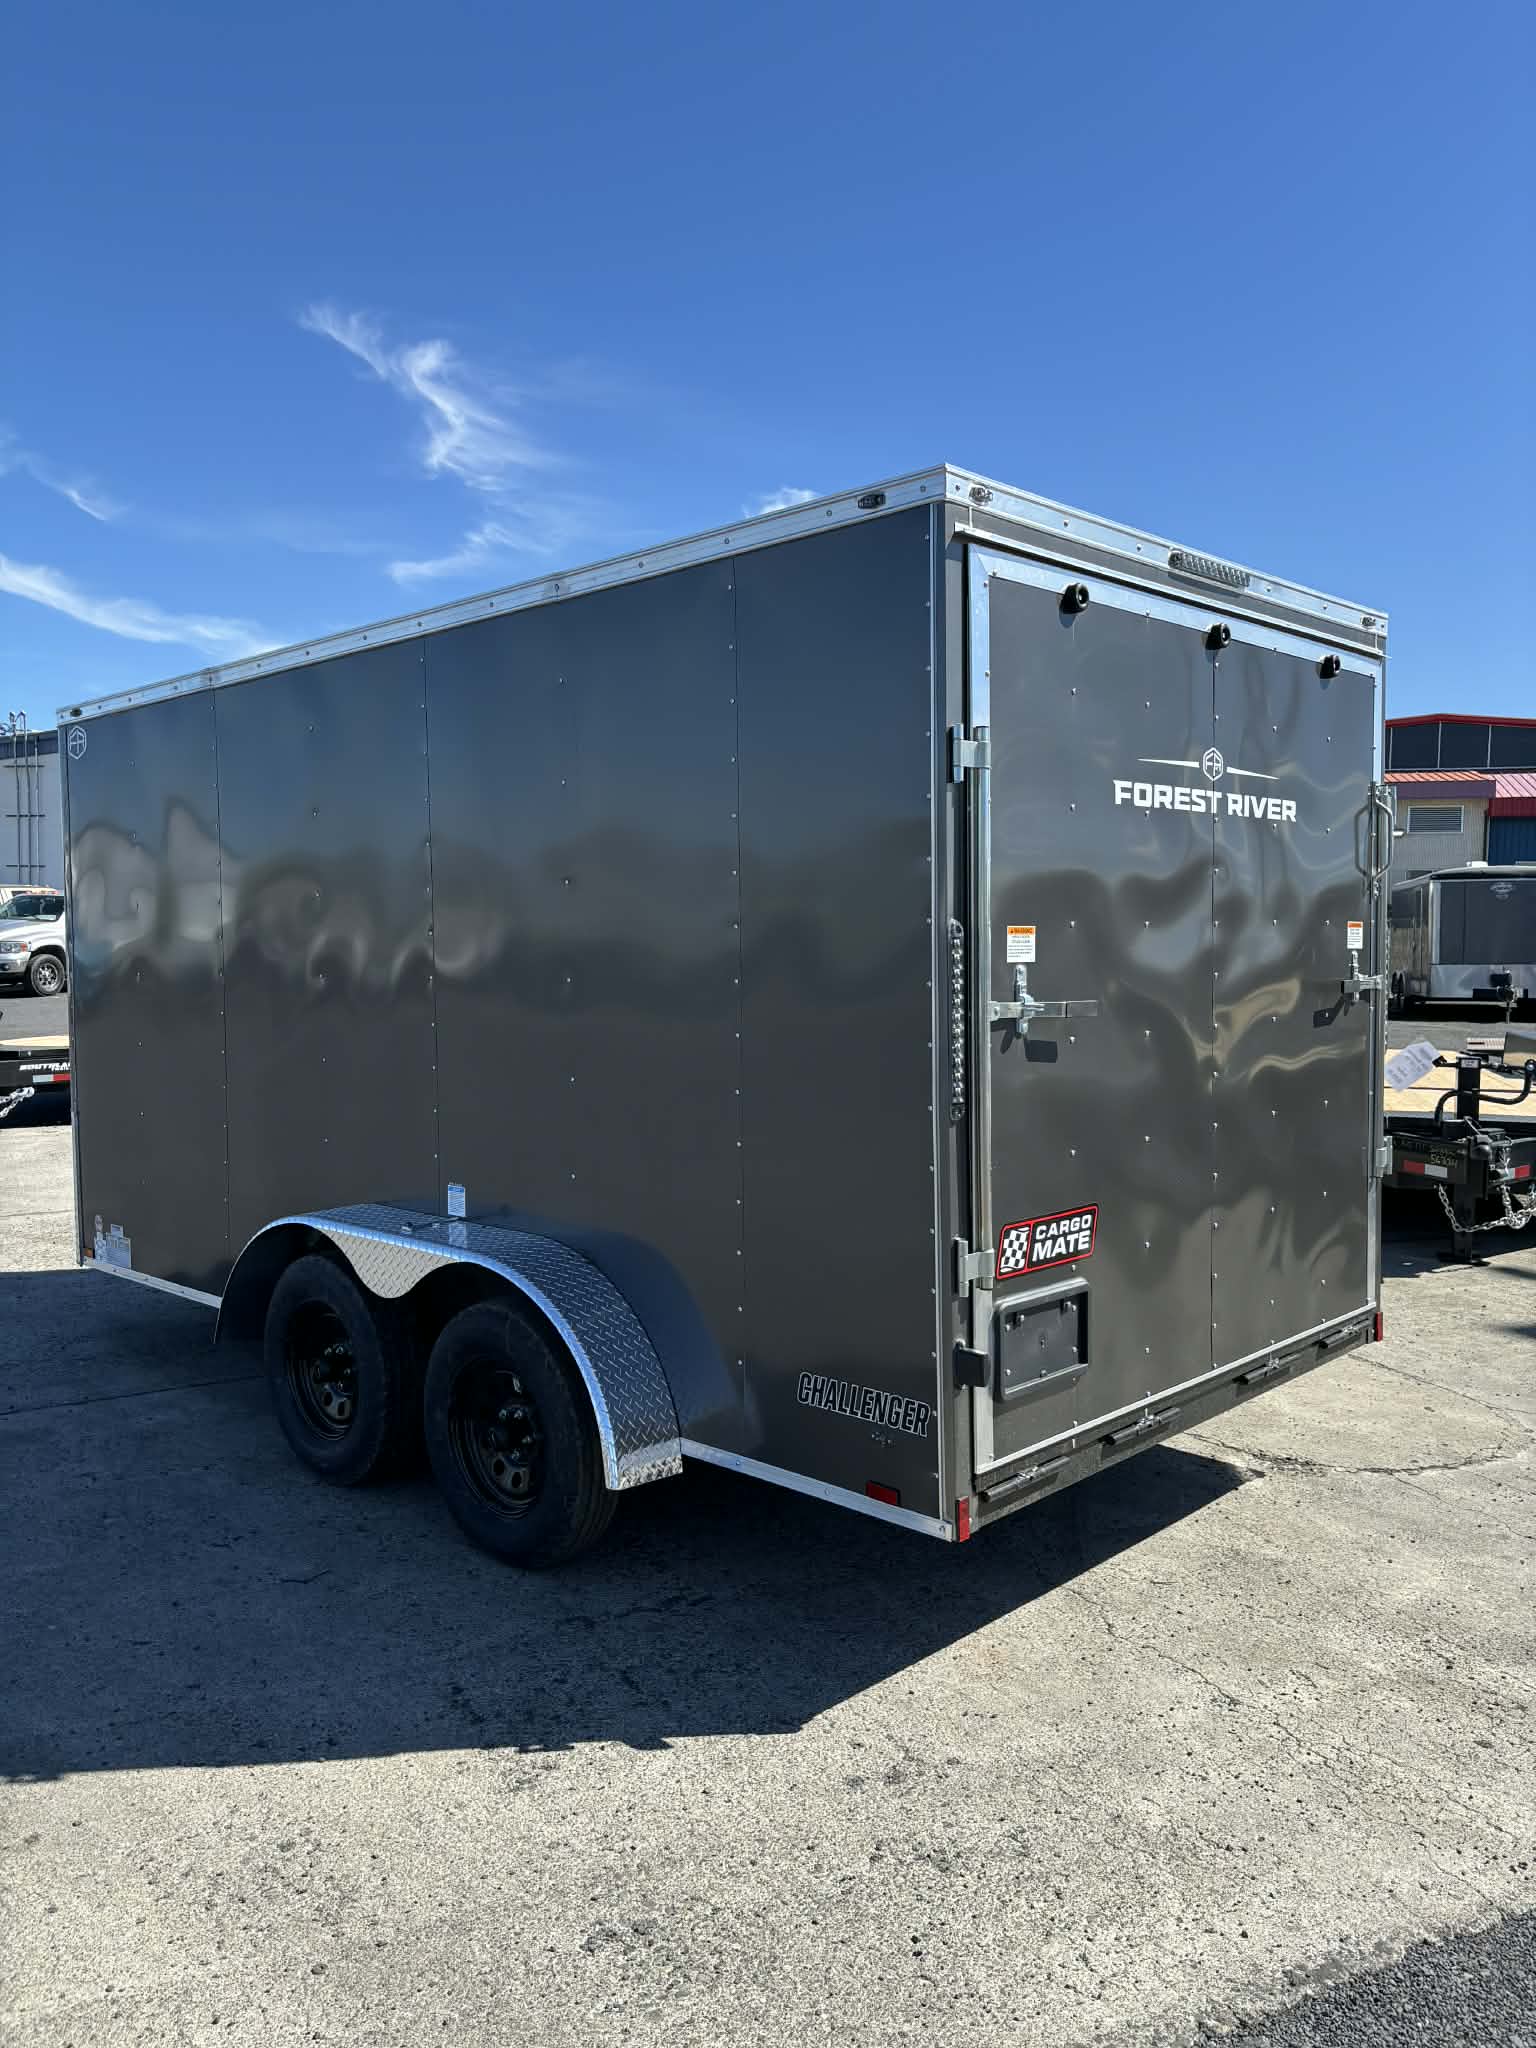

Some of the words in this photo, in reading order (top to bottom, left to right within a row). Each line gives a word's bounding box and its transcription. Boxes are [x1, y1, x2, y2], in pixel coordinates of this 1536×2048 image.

[1113, 779, 1222, 813] FOREST
[1226, 793, 1297, 822] RIVER
[1032, 1229, 1091, 1262] MATE
[1035, 1214, 1092, 1240] CARGO
[797, 1371, 931, 1437] CHALLENGER
